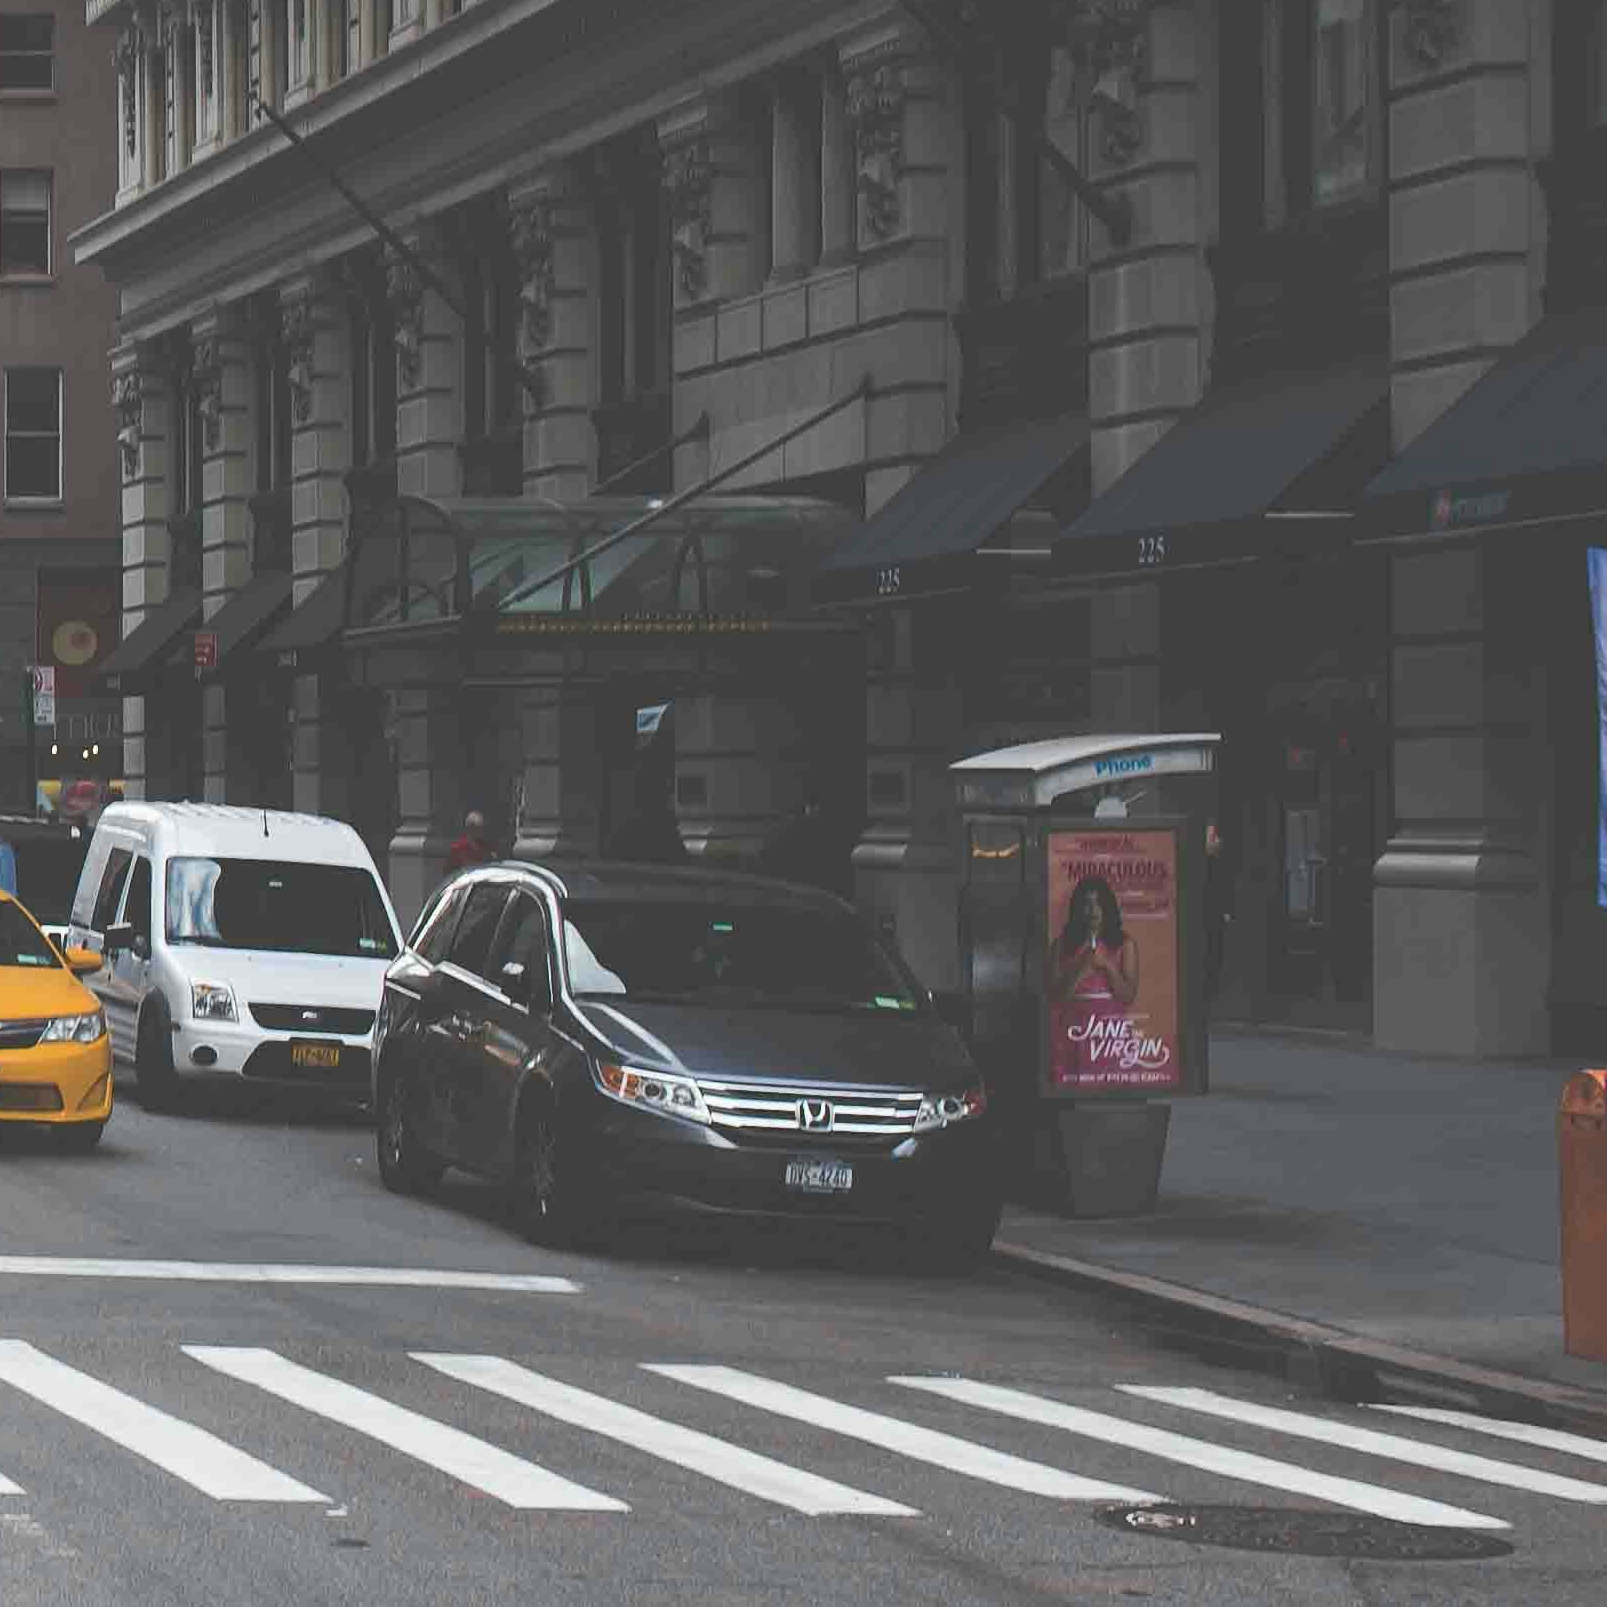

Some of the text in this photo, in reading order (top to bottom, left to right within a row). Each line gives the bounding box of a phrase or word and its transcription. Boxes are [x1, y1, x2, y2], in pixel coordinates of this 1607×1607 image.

[1138, 537, 1165, 563] 225
[1095, 756, 1152, 774] Phone
[1068, 1013, 1134, 1042] JANE
[1090, 1037, 1169, 1069] VIRGIN
